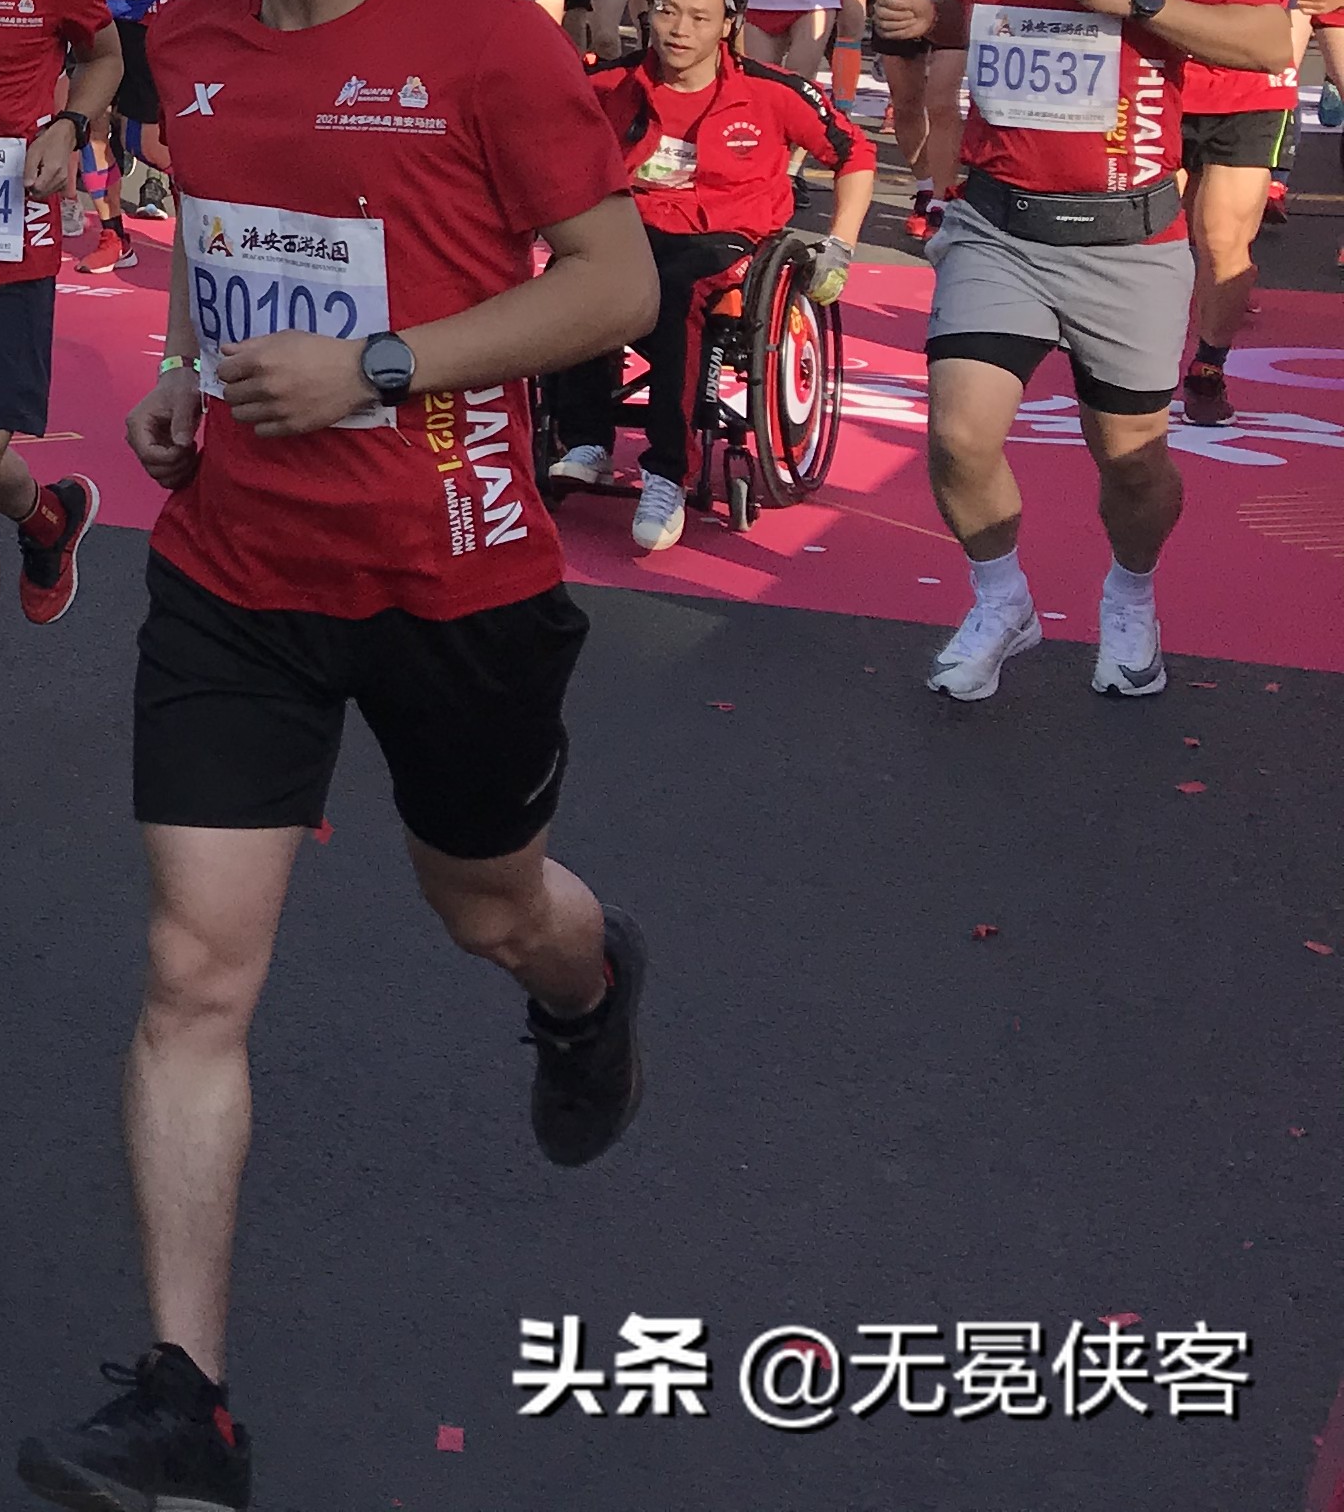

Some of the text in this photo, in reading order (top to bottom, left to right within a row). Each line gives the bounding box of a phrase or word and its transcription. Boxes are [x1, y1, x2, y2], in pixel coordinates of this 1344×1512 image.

[1020, 18, 1099, 38] 淮安西游乐园
[976, 44, 1106, 96] B0537
[315, 113, 339, 125] 2021
[240, 226, 351, 265] 淮安西游乐园
[424, 391, 464, 473] 2021
[442, 477, 464, 557] MARATHON
[460, 496, 476, 553] HUAI'AN
